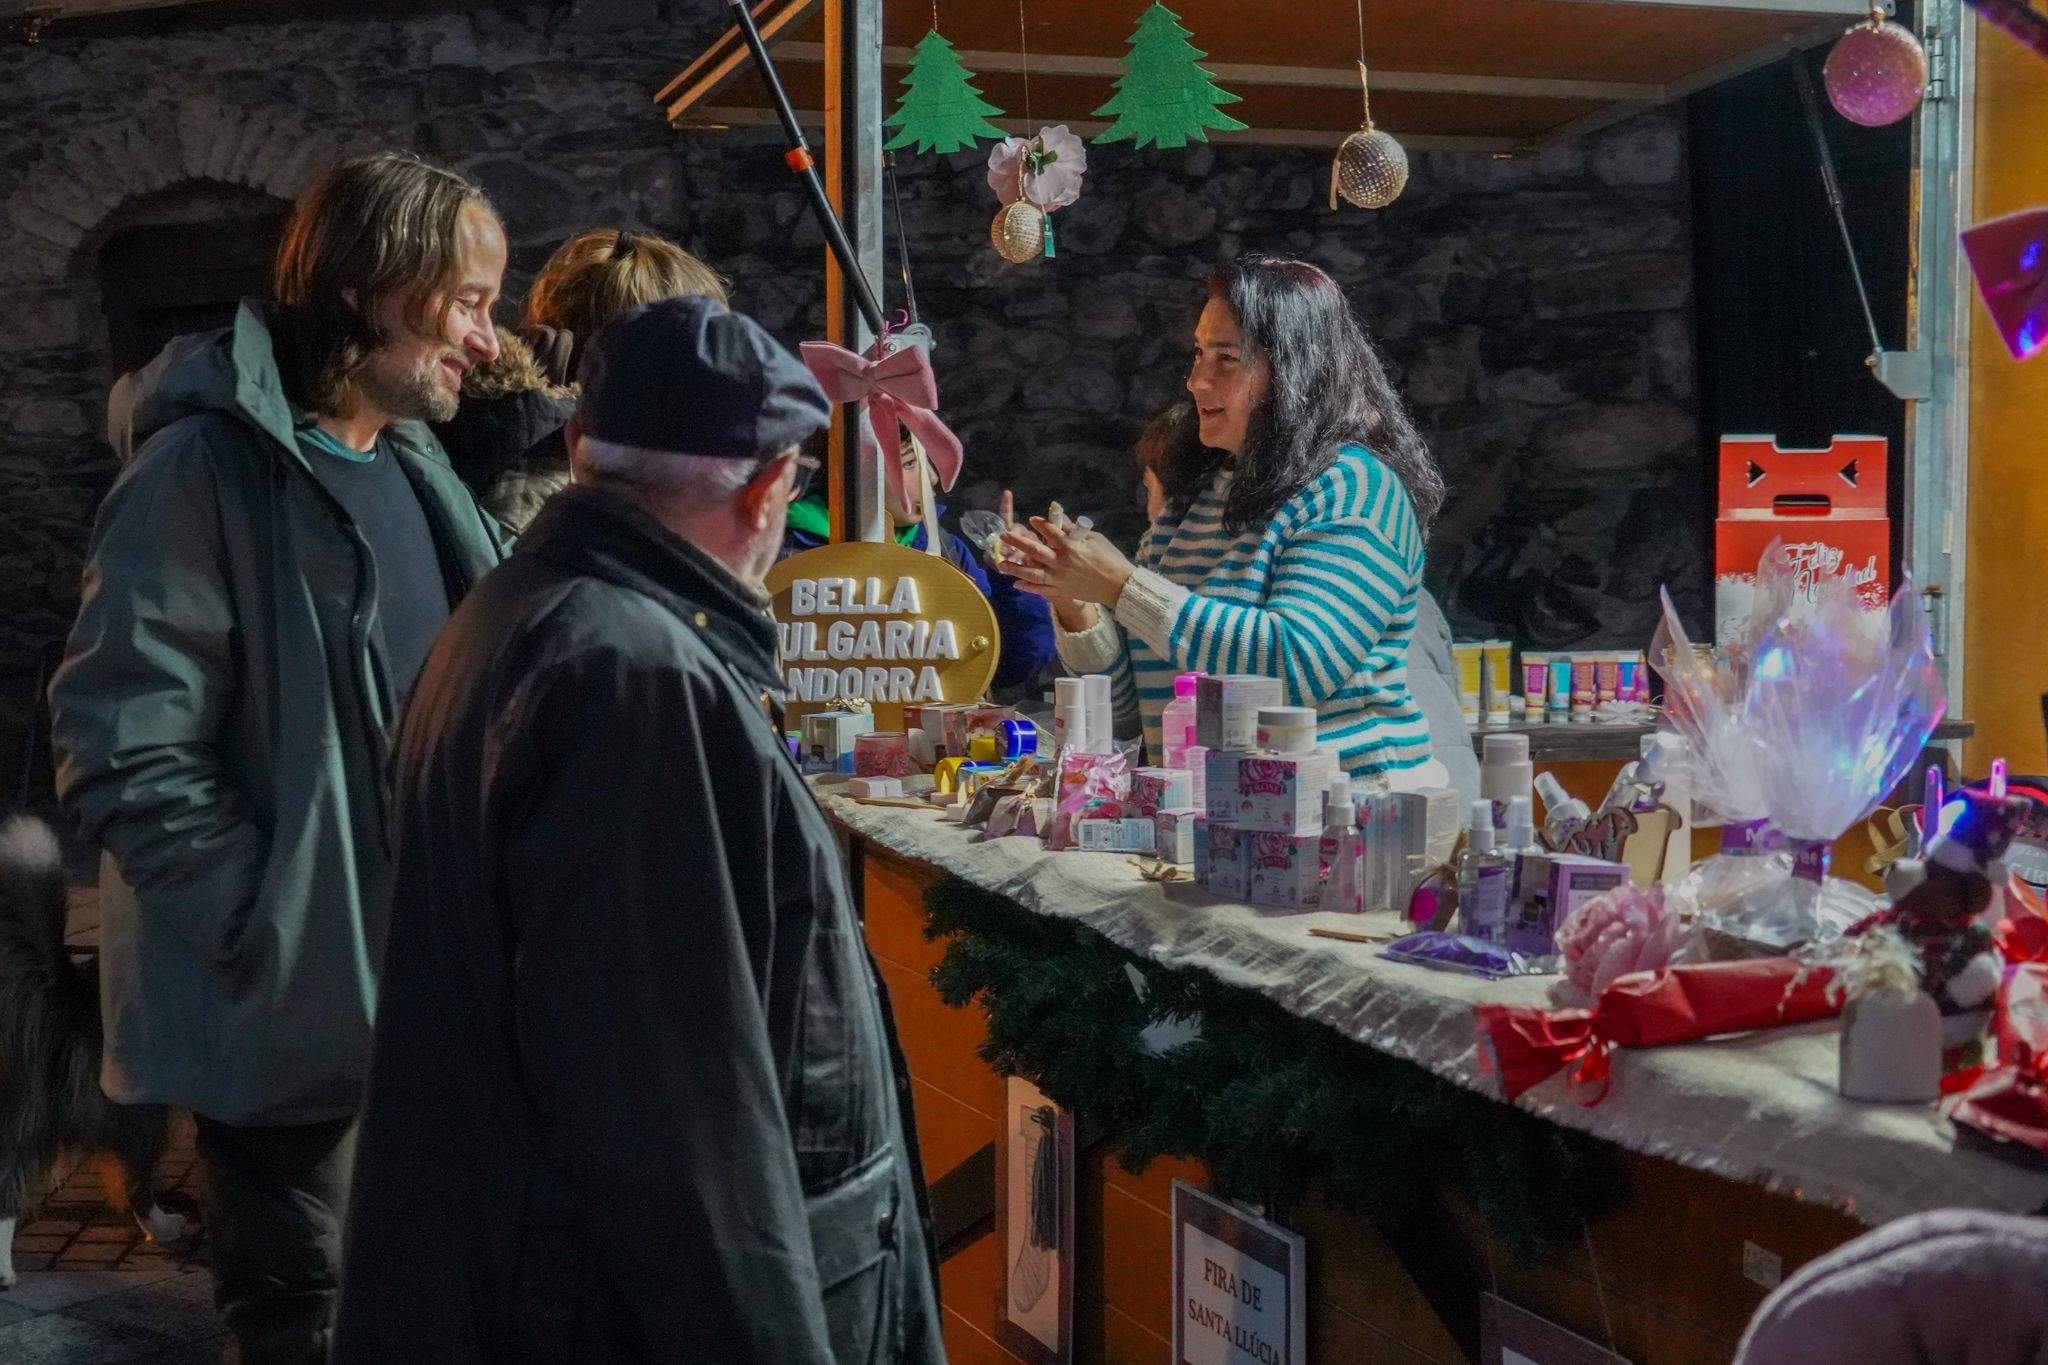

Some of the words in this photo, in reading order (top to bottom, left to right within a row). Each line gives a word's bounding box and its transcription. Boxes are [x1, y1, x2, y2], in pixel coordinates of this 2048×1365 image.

[792, 576, 921, 616] BELLA
[777, 619, 959, 661] ULGARIA
[786, 665, 944, 703] NDORRA
[1254, 783, 1281, 794] ROSE
[1204, 1257, 1238, 1298] FIRA
[1242, 1279, 1262, 1312] DE
[1188, 1298, 1232, 1342] SANTA
